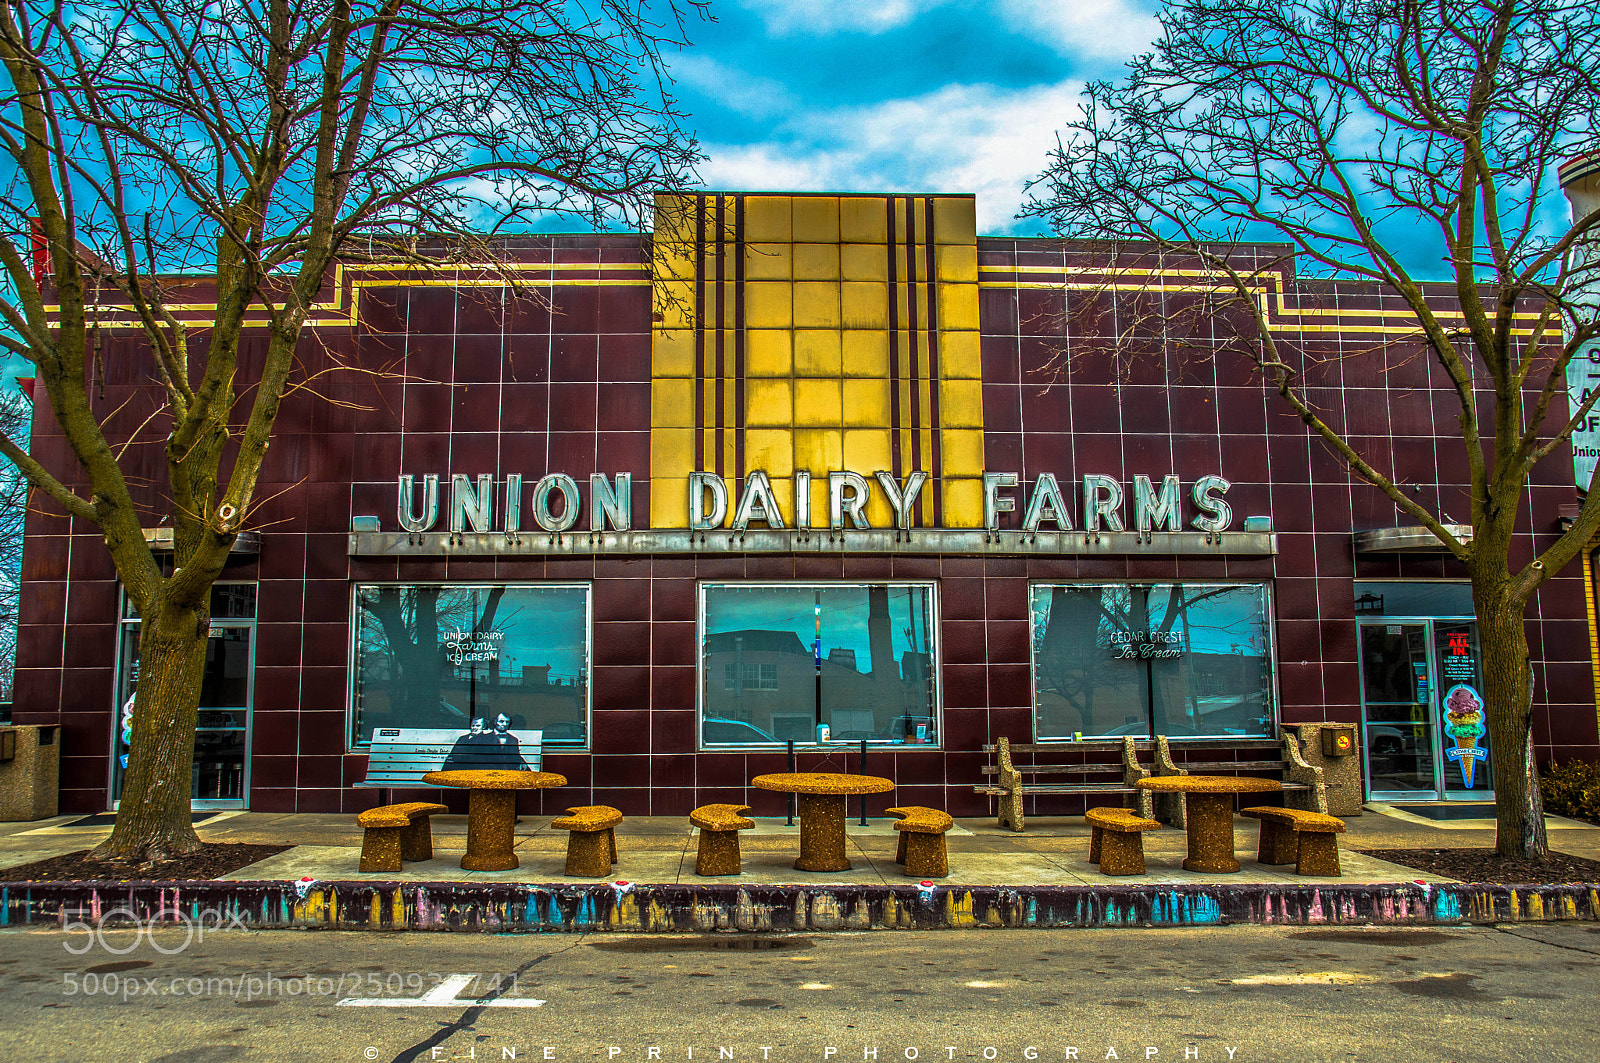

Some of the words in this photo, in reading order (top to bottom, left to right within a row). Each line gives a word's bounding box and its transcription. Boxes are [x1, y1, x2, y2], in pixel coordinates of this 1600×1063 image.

[398, 473, 632, 532] UNION
[689, 471, 928, 530] DAIRY
[983, 471, 1233, 532] FARMS
[209, 628, 222, 636] 26
[443, 632, 473, 640] UNION
[477, 632, 504, 640] DAIRY
[1110, 631, 1144, 643] CEDAR
[1150, 631, 1182, 643] CREST
[1448, 638, 1469, 647] ALL
[446, 652, 462, 662] ICE
[465, 651, 498, 661] CREAM
[1115, 644, 1138, 659] Ice
[1139, 644, 1181, 658] Cream
